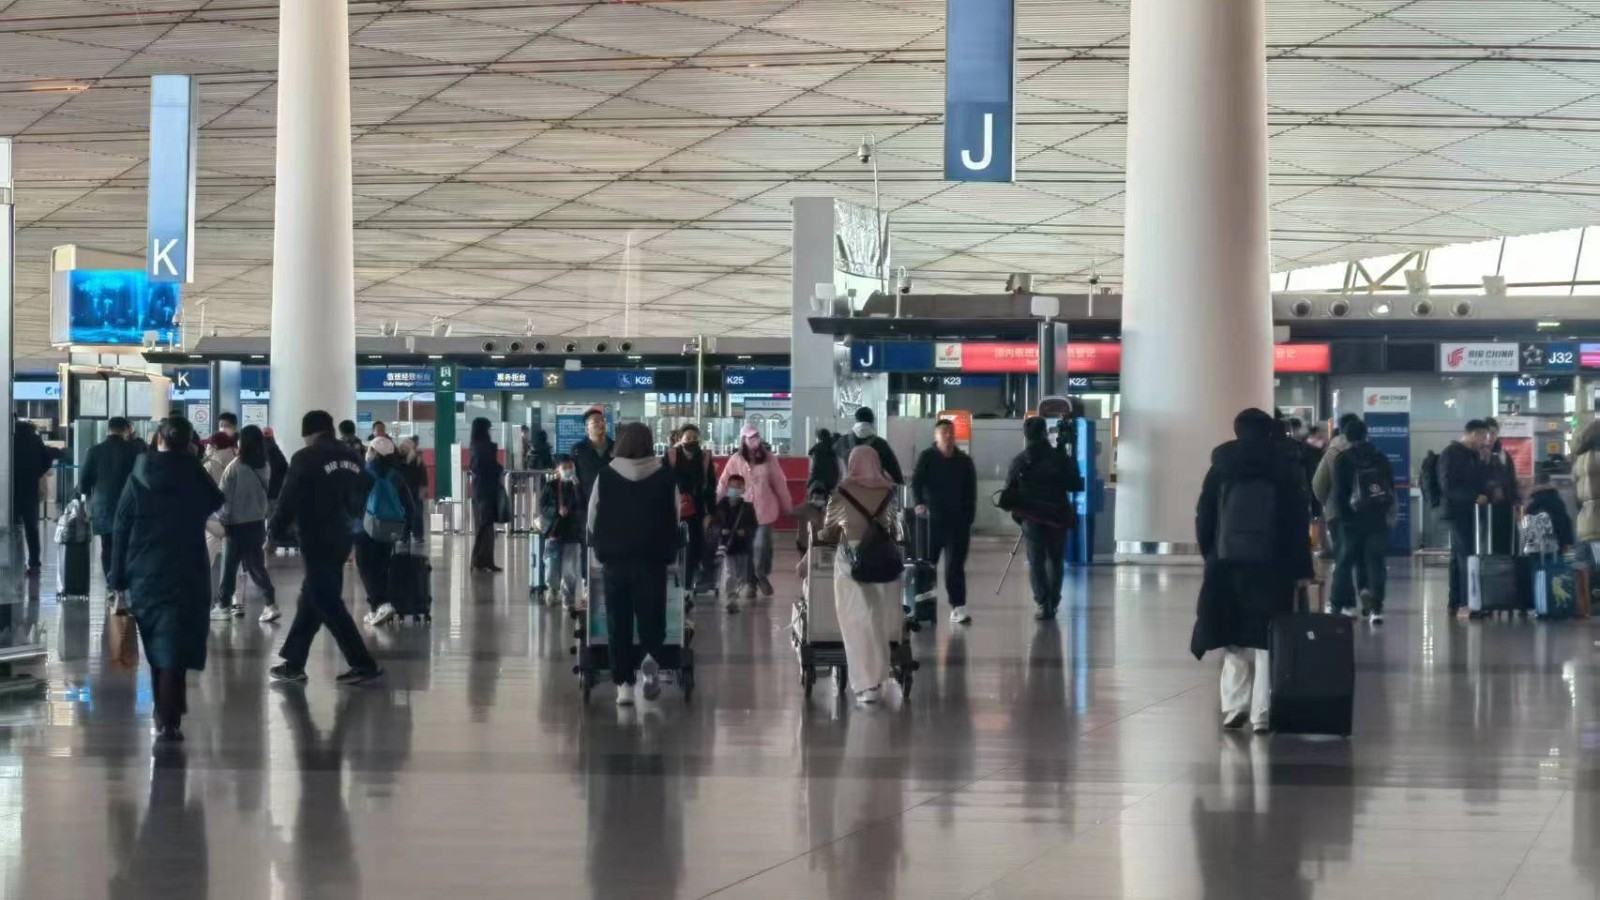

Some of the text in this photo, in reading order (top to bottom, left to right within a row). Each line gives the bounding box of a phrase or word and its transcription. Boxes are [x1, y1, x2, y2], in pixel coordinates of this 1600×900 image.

[961, 113, 993, 171] J
[153, 238, 178, 276] K
[859, 345, 874, 367] J
[1468, 349, 1514, 358] AIR CHINA
[1548, 351, 1573, 364] J32
[177, 372, 189, 387] K
[635, 376, 653, 385] K26
[726, 376, 745, 385] K25
[943, 376, 962, 386] K23
[1069, 377, 1088, 386] K22
